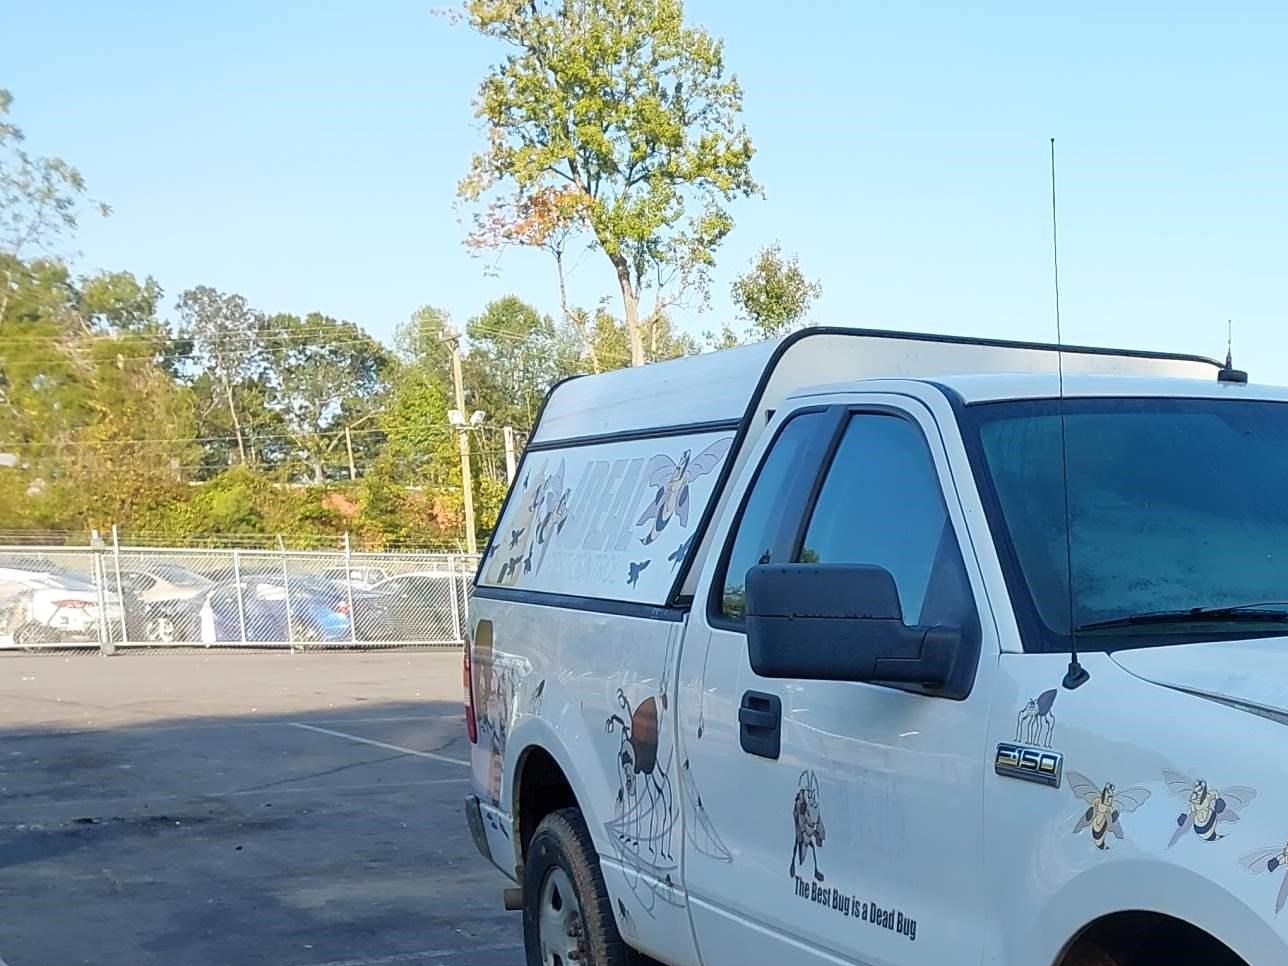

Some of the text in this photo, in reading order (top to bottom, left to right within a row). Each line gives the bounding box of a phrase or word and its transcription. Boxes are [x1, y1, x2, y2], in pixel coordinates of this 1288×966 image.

[795, 876, 918, 941] The Best Bug is a Dead Bug
